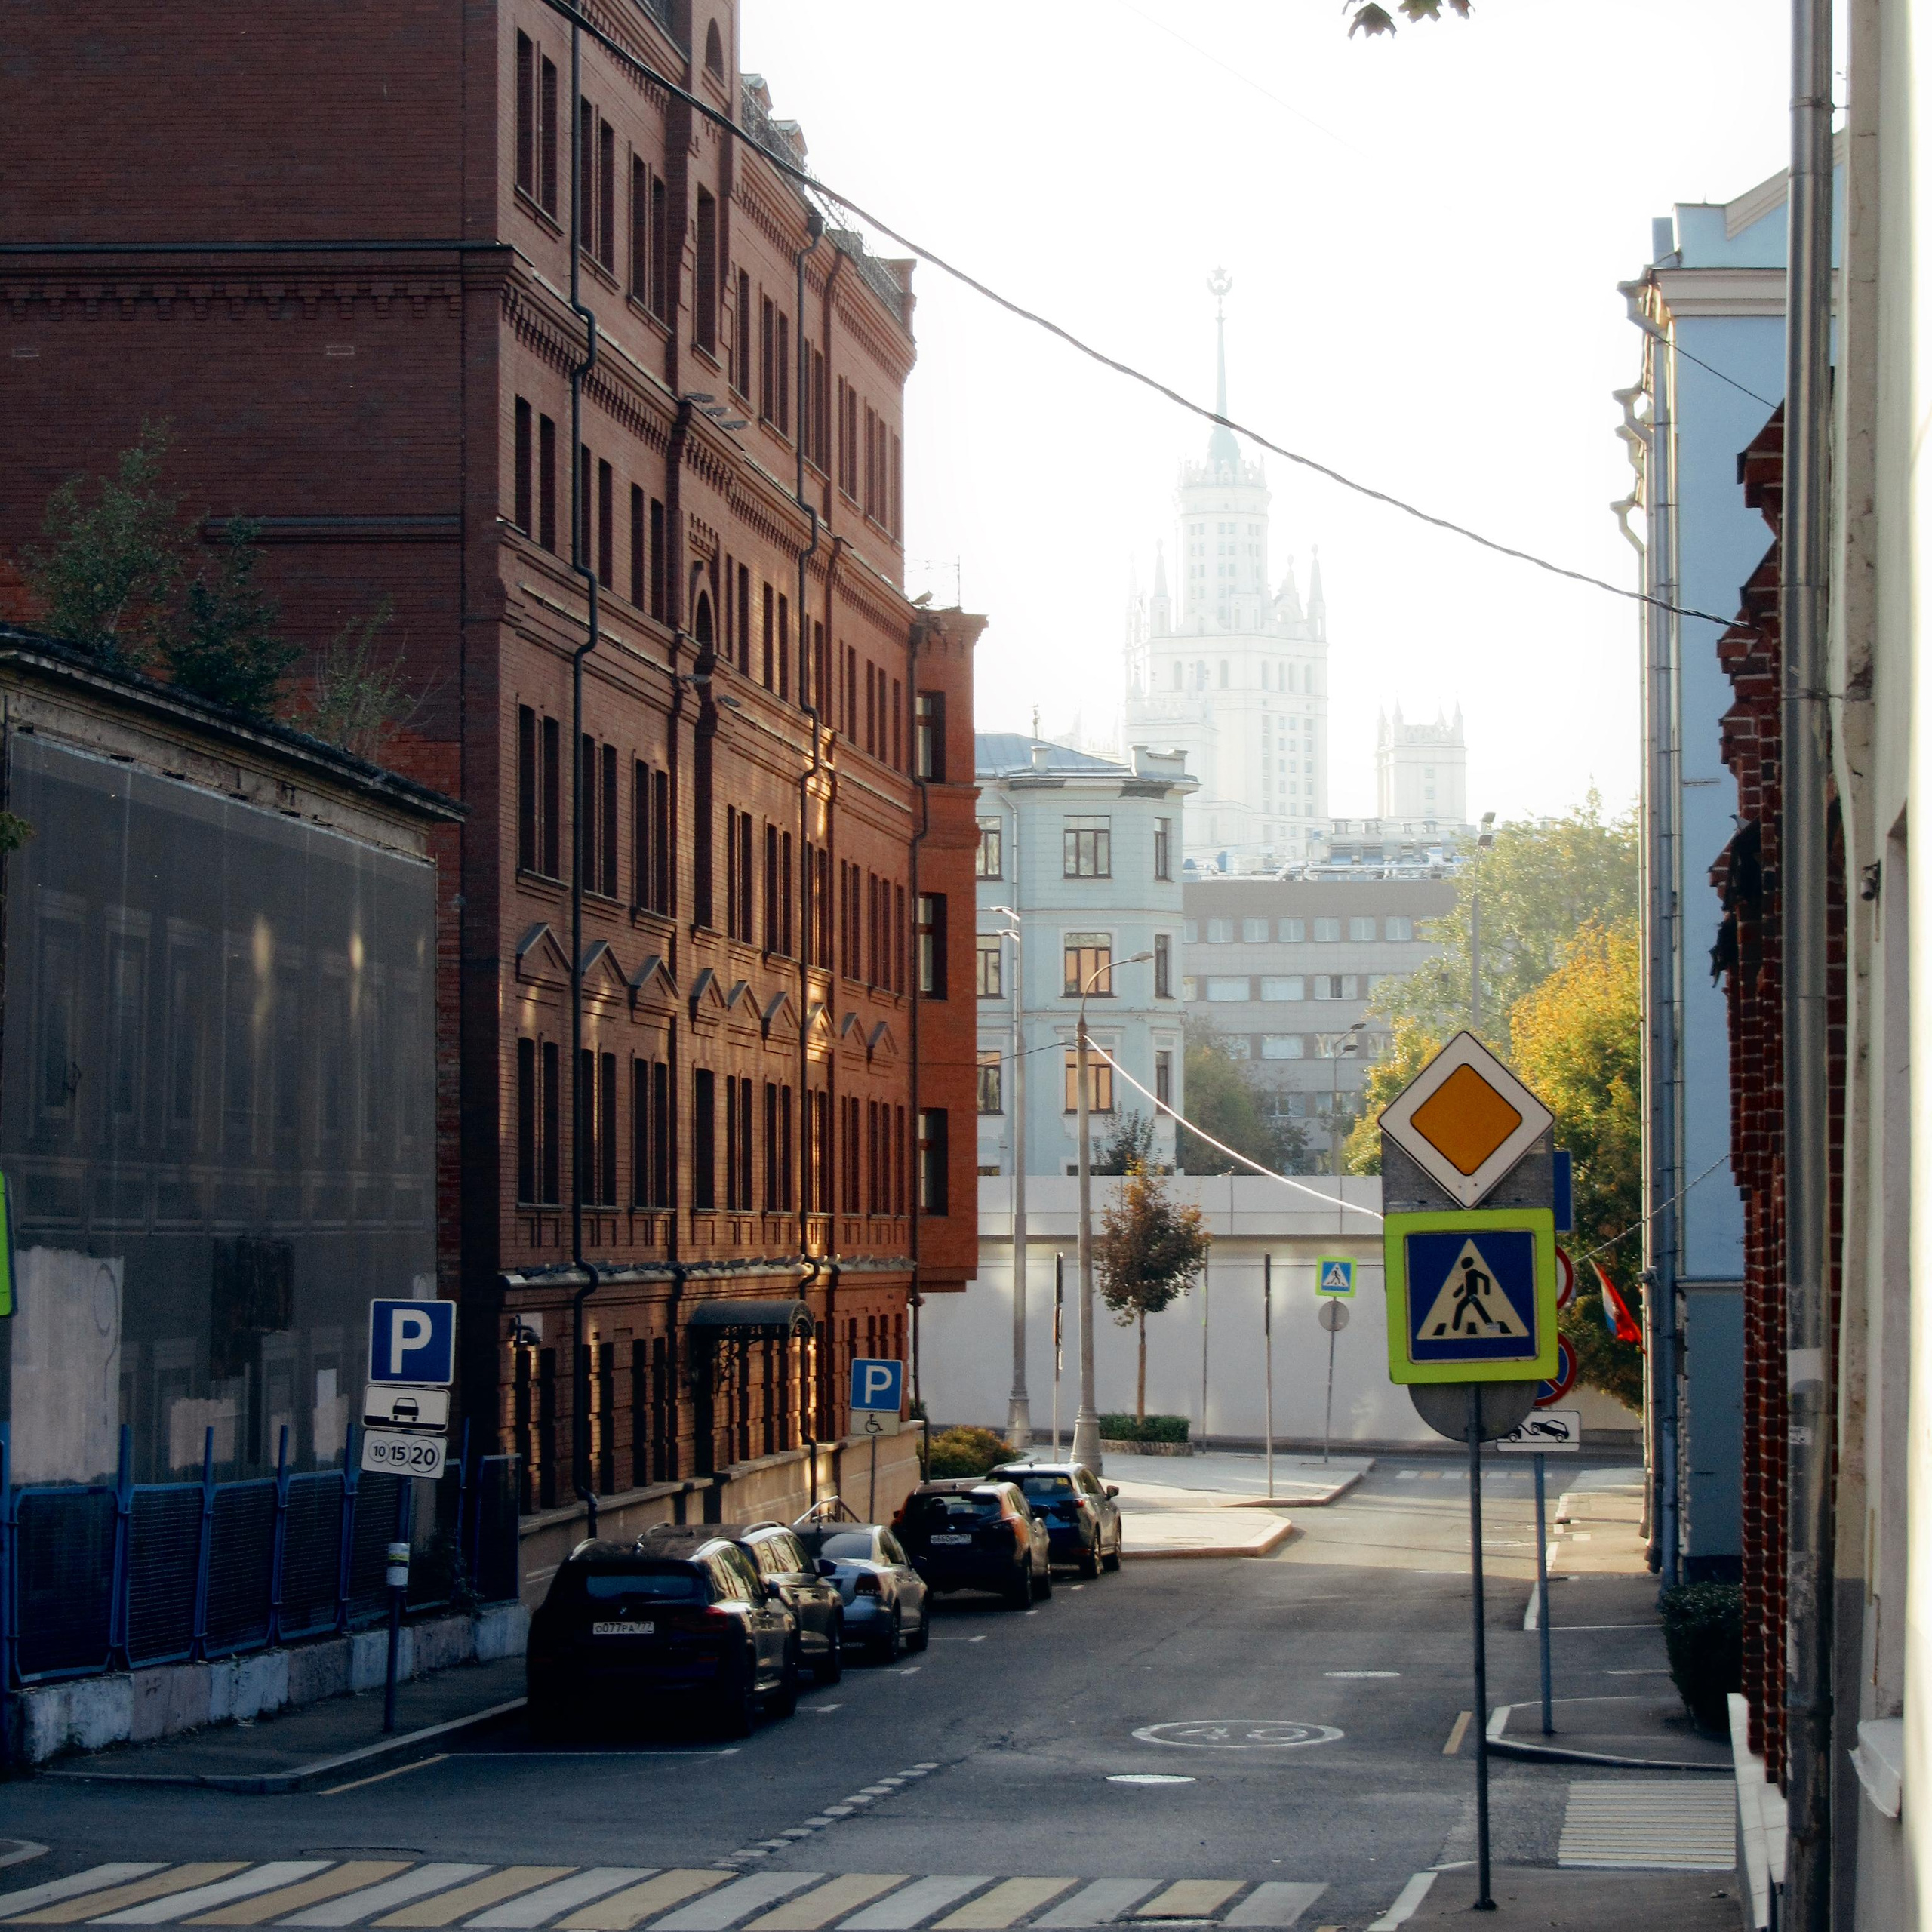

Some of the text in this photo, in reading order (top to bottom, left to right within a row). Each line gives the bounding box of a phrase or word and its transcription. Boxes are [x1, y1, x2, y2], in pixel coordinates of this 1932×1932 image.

[390, 1309, 433, 1374] P
[865, 1365, 892, 1404] P
[374, 1446, 435, 1466] 10 15 20
